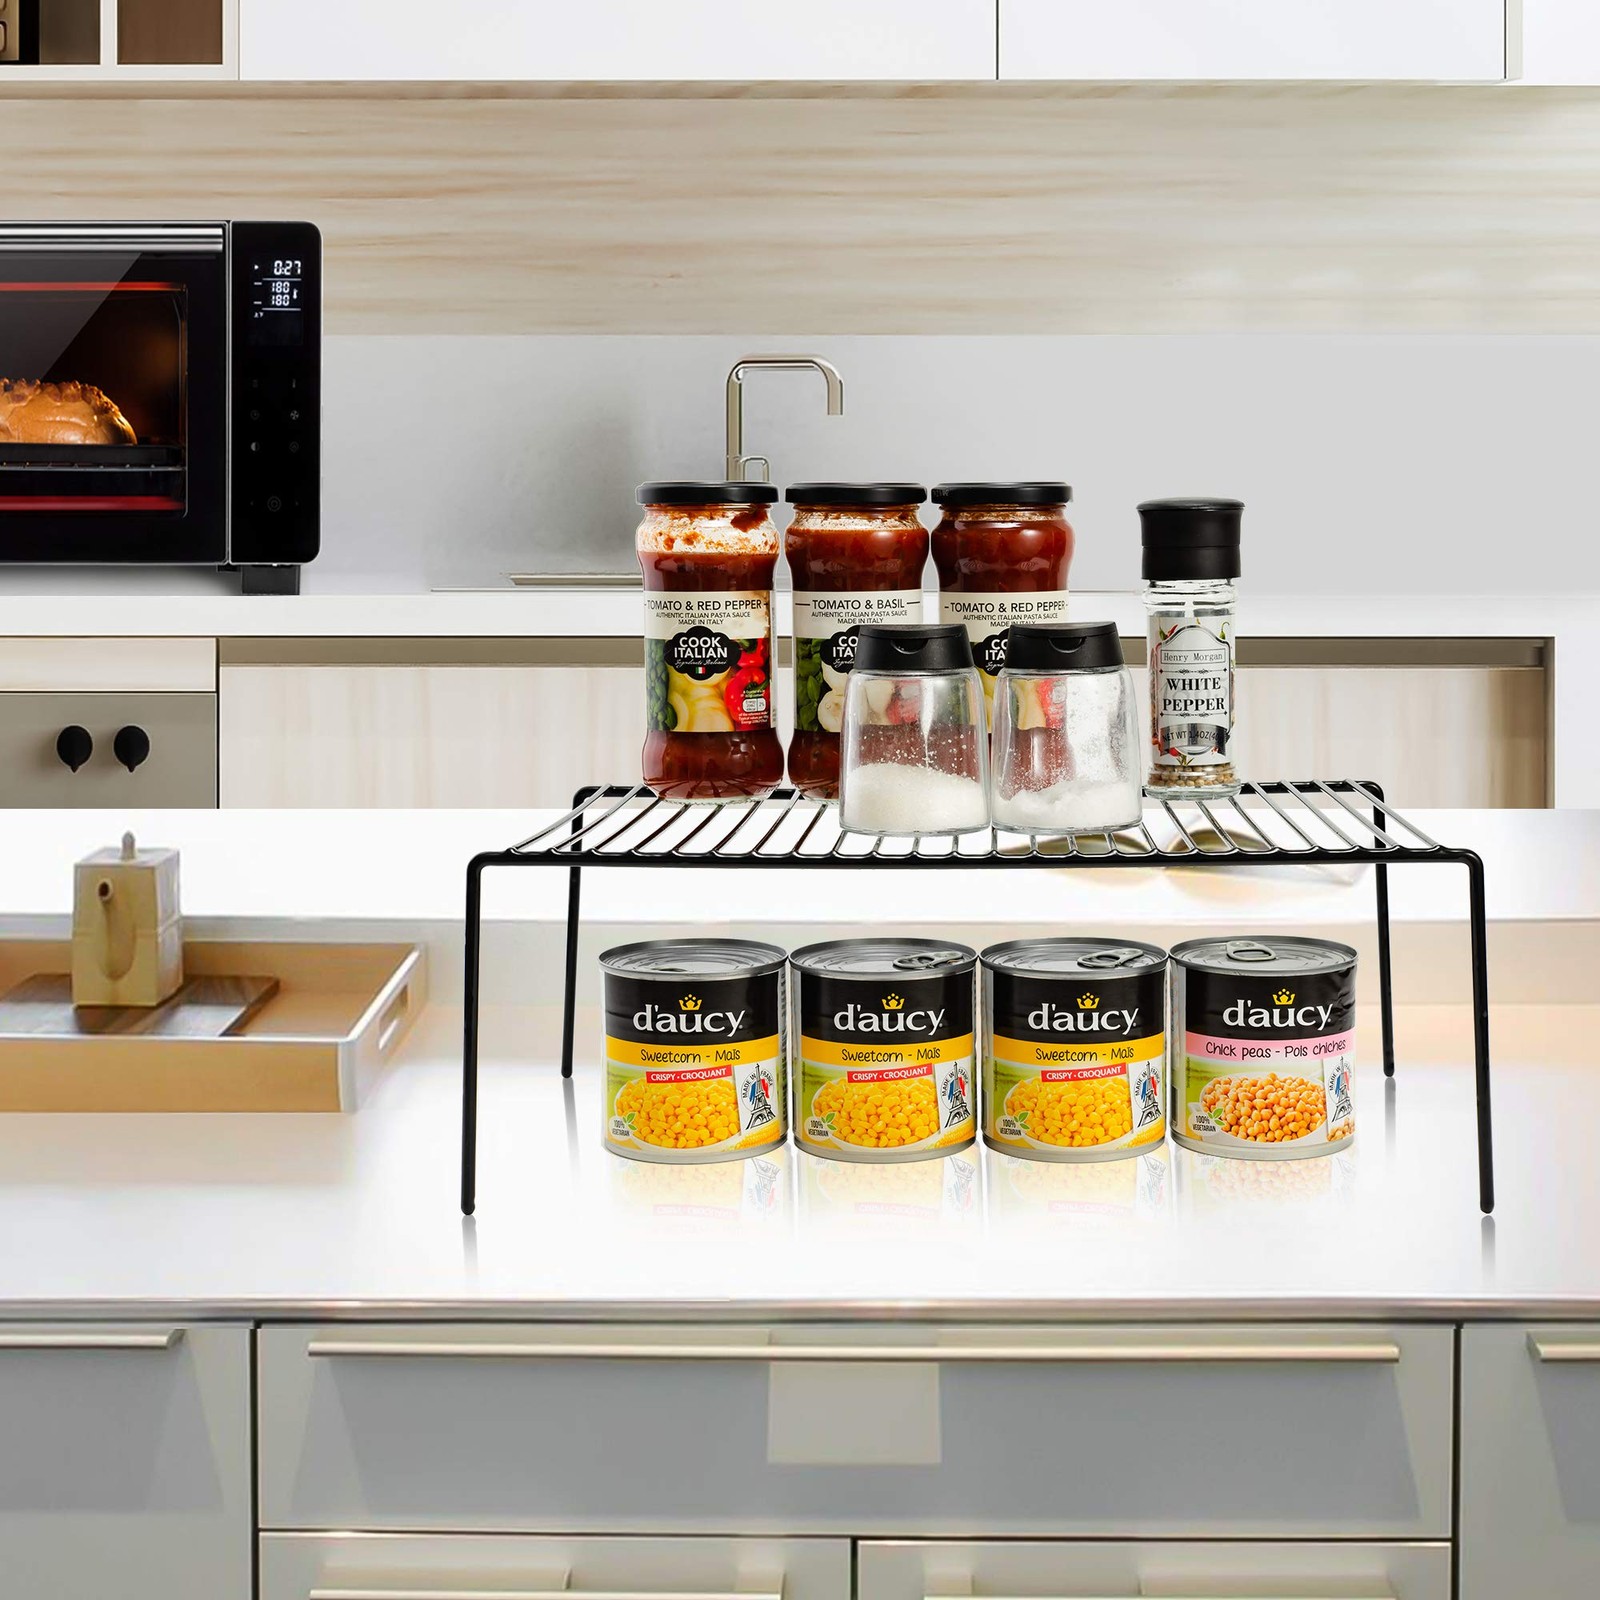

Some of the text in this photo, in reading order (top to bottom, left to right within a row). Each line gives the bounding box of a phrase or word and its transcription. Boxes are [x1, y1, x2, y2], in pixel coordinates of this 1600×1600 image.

[273, 260, 302, 276] 0:27
[271, 281, 290, 293] 180
[271, 294, 290, 306] 180
[647, 599, 762, 611] TOMATO & RED PEPPER
[812, 598, 905, 610] TOMATO & BASIL
[950, 600, 1065, 613] TOMATO & RED PEPPER
[679, 636, 721, 648] COOK
[838, 635, 858, 647] CO
[991, 639, 1008, 650] CO
[674, 647, 728, 658] ITALIAN
[1163, 652, 1223, 662] Henry Morgan
[1166, 677, 1221, 691] WHITE
[1163, 697, 1225, 711] PEPPER
[1175, 731, 1187, 739] WT
[633, 1004, 745, 1037] d'aucy
[833, 1003, 945, 1036] d'aucy
[1027, 1003, 1139, 1035] d'aucy
[1222, 999, 1333, 1031] d'aucy
[640, 1049, 701, 1063] Sweetcorn
[714, 1049, 741, 1062] Maïs
[841, 1048, 903, 1062] Sweetcorn
[916, 1047, 941, 1061] Maïs
[1035, 1047, 1098, 1062] Sweetcorn
[1110, 1046, 1135, 1060] Maïs
[1205, 1041, 1237, 1057] Chick
[1241, 1044, 1271, 1060] peas
[1284, 1044, 1308, 1058] Pois
[1313, 1039, 1347, 1055] chiches
[651, 1068, 727, 1081] CRISPY CROQUANT
[852, 1067, 927, 1081] CRISPY CROQUANT
[1046, 1066, 1121, 1080] CRISPY CROQUANT
[1195, 1115, 1210, 1125] 100%
[1192, 1123, 1217, 1132] VEGETARIAN
